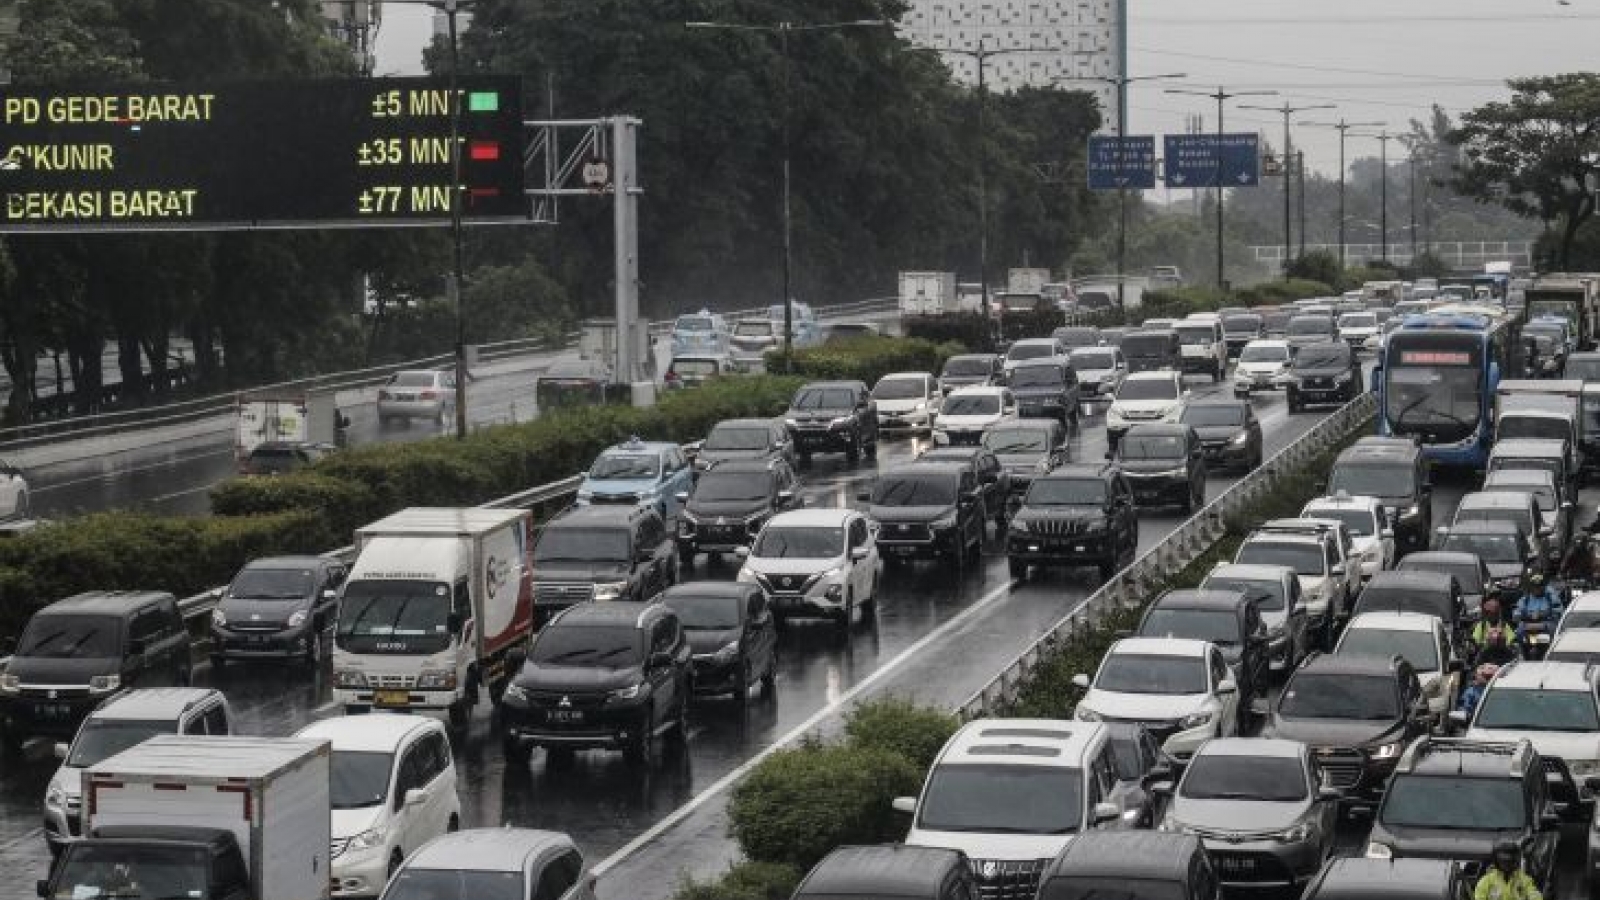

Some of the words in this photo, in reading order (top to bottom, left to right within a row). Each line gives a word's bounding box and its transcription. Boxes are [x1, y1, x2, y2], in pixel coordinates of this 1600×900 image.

[6, 97, 41, 123] PD
[48, 96, 119, 122] GEDE
[128, 94, 215, 121] BARAT
[372, 90, 402, 117] ±5
[358, 138, 402, 165] ±35
[110, 190, 197, 217] BARAT
[358, 186, 402, 214] ±77
